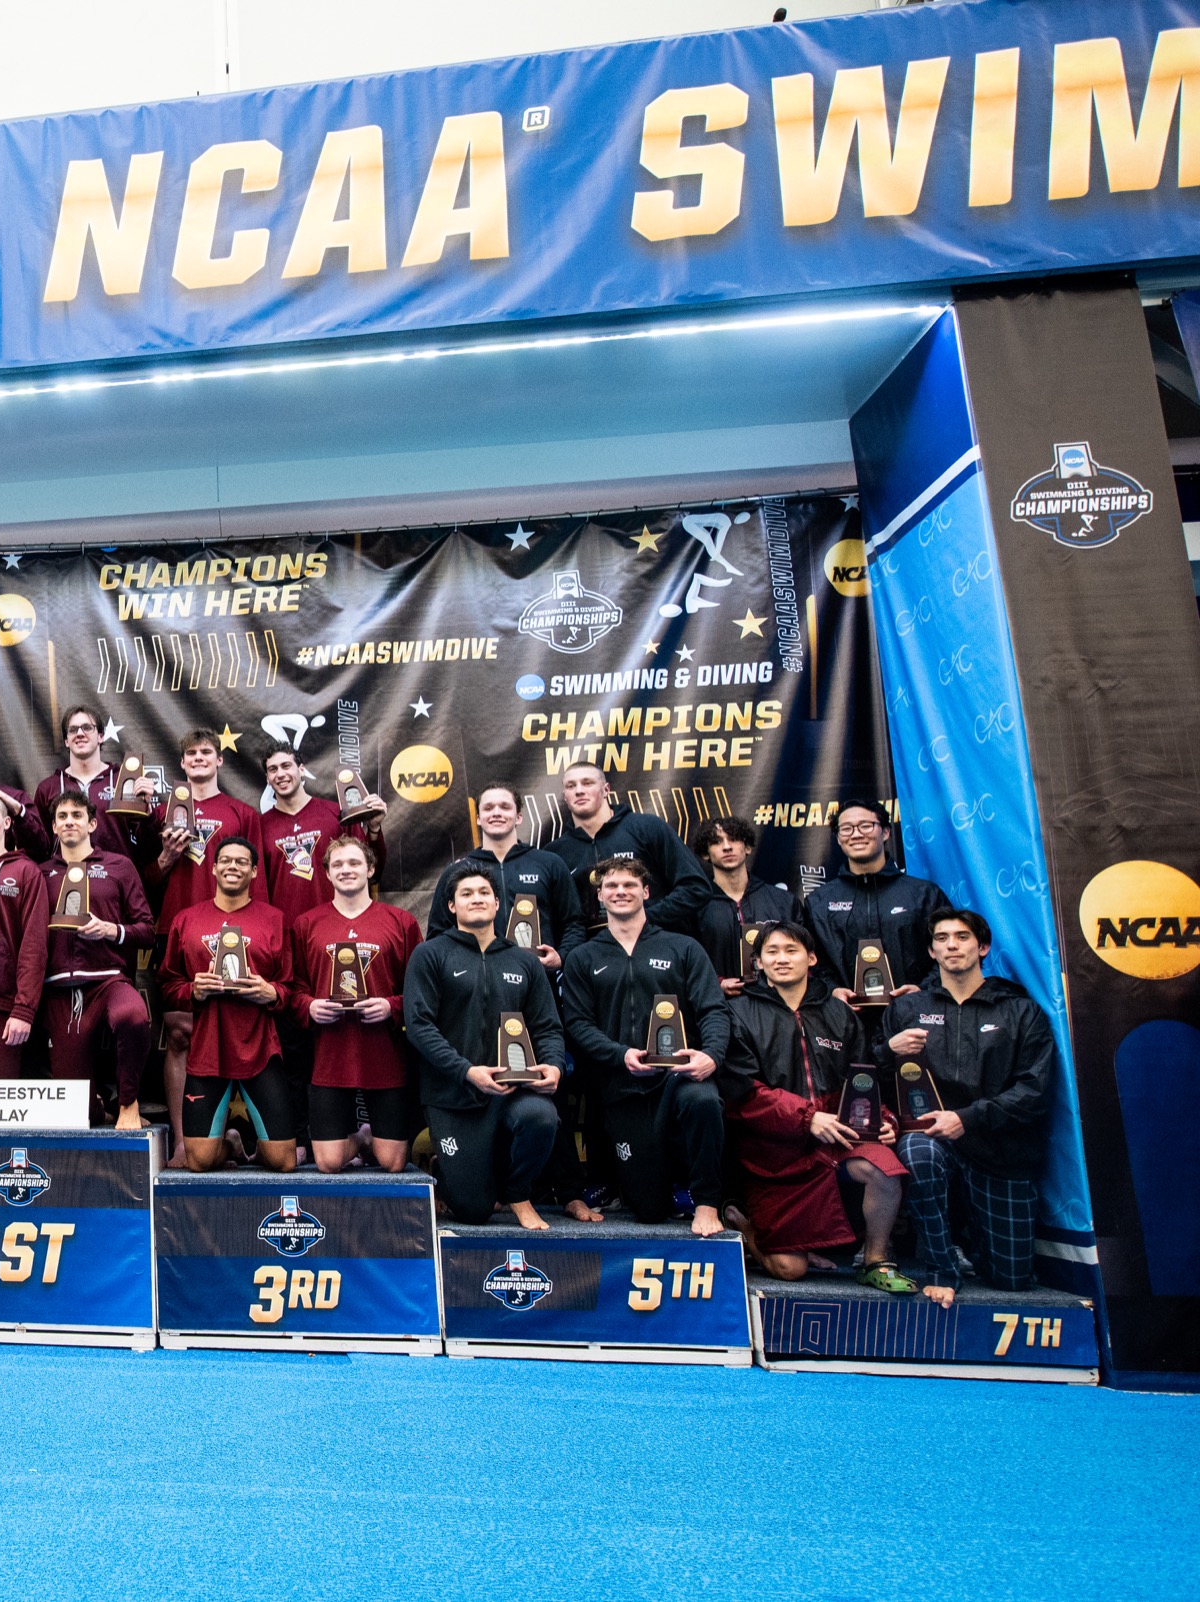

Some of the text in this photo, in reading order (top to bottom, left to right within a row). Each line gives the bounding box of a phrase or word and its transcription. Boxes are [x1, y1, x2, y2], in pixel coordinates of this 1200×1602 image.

[1030, 488, 1085, 500] SWIMMING
[1095, 486, 1130, 496] DIVING
[1067, 481, 1089, 490] DIII
[1015, 494, 1149, 516] CHAMPIONSHIPS
[100, 553, 328, 591] CHAMPIONS
[832, 565, 869, 583] NCA
[118, 593, 192, 621] WIN
[522, 611, 619, 630] CHAMPIONSHIPS
[296, 637, 499, 666] #NCAASWIMDIVE
[518, 661, 774, 697] NCAA SWIMMING & DIVING
[521, 700, 783, 743] CHAMPIONS
[397, 770, 453, 790] NCAA
[518, 874, 539, 882] NYU
[649, 958, 672, 968] NYU
[502, 973, 523, 983] NYU
[260, 1228, 323, 1237] CHAMPIONSHIPS
[248, 1265, 342, 1324] 3RD
[486, 1281, 550, 1291] CHAMPIONSHIPS
[628, 1258, 714, 1312] 5TH
[992, 1313, 1062, 1356] 7TH
